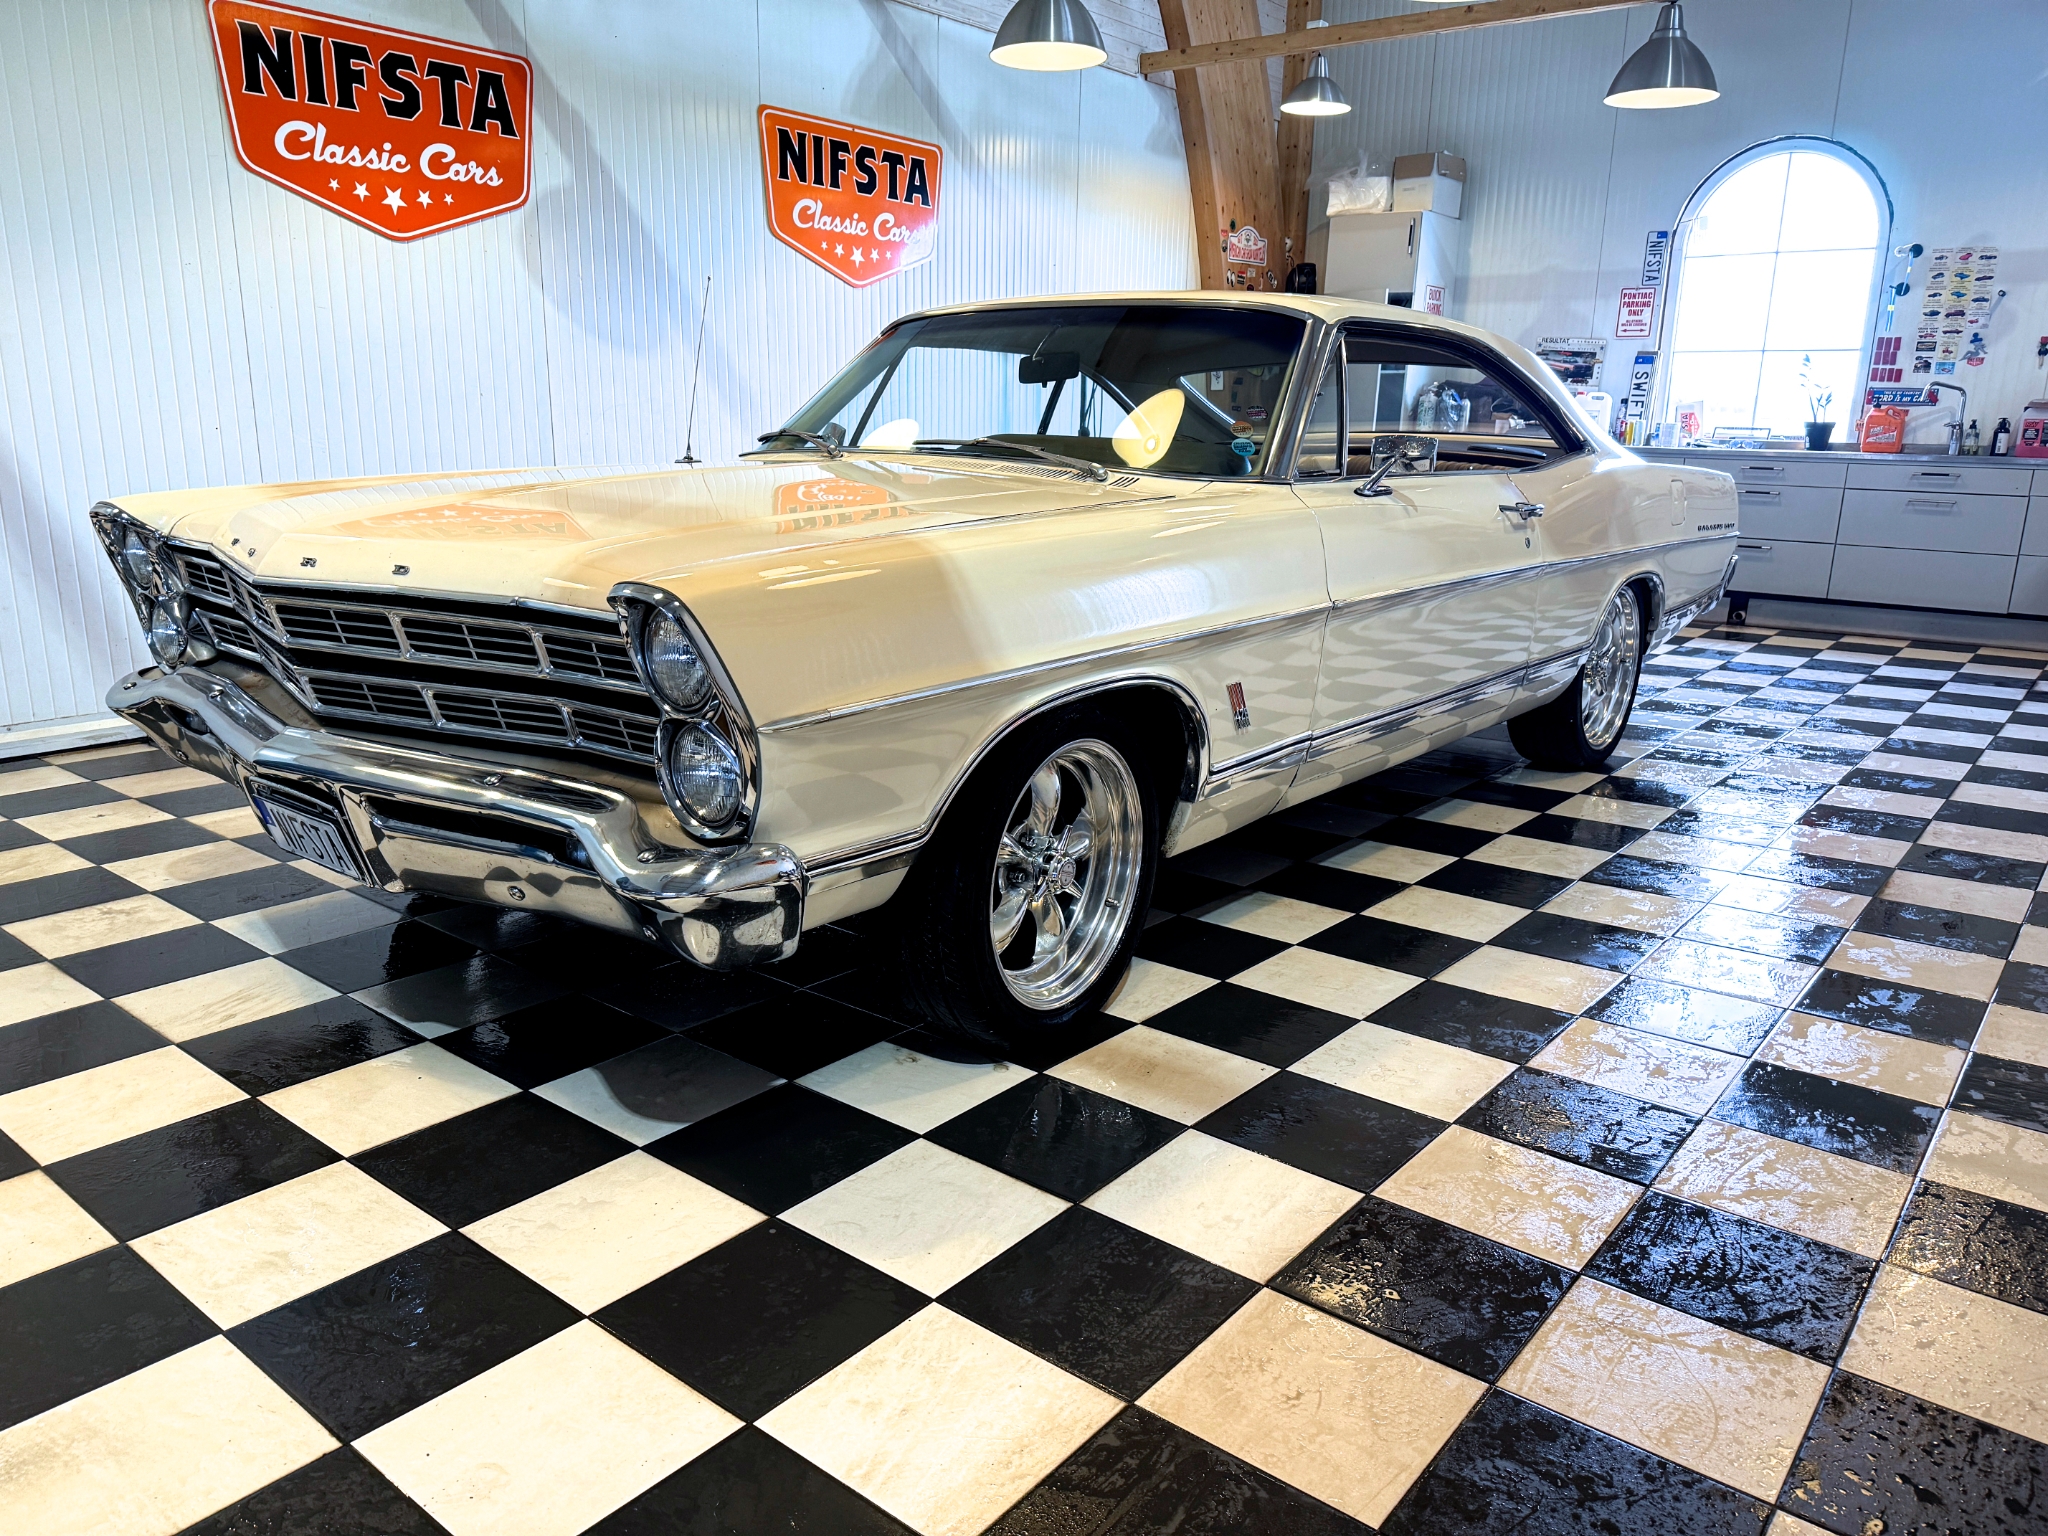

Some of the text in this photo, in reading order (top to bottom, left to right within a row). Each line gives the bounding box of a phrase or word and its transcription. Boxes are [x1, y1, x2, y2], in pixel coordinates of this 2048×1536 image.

[235, 19, 520, 139] NIFSTA
[274, 120, 503, 187] Classic Cars
[776, 126, 932, 208] NIFSTA
[792, 198, 921, 245] Classic Cars
[1645, 241, 1664, 282] NIFSTA
[1628, 371, 1649, 420] SWIFT
[270, 808, 351, 871] NIFSTA
